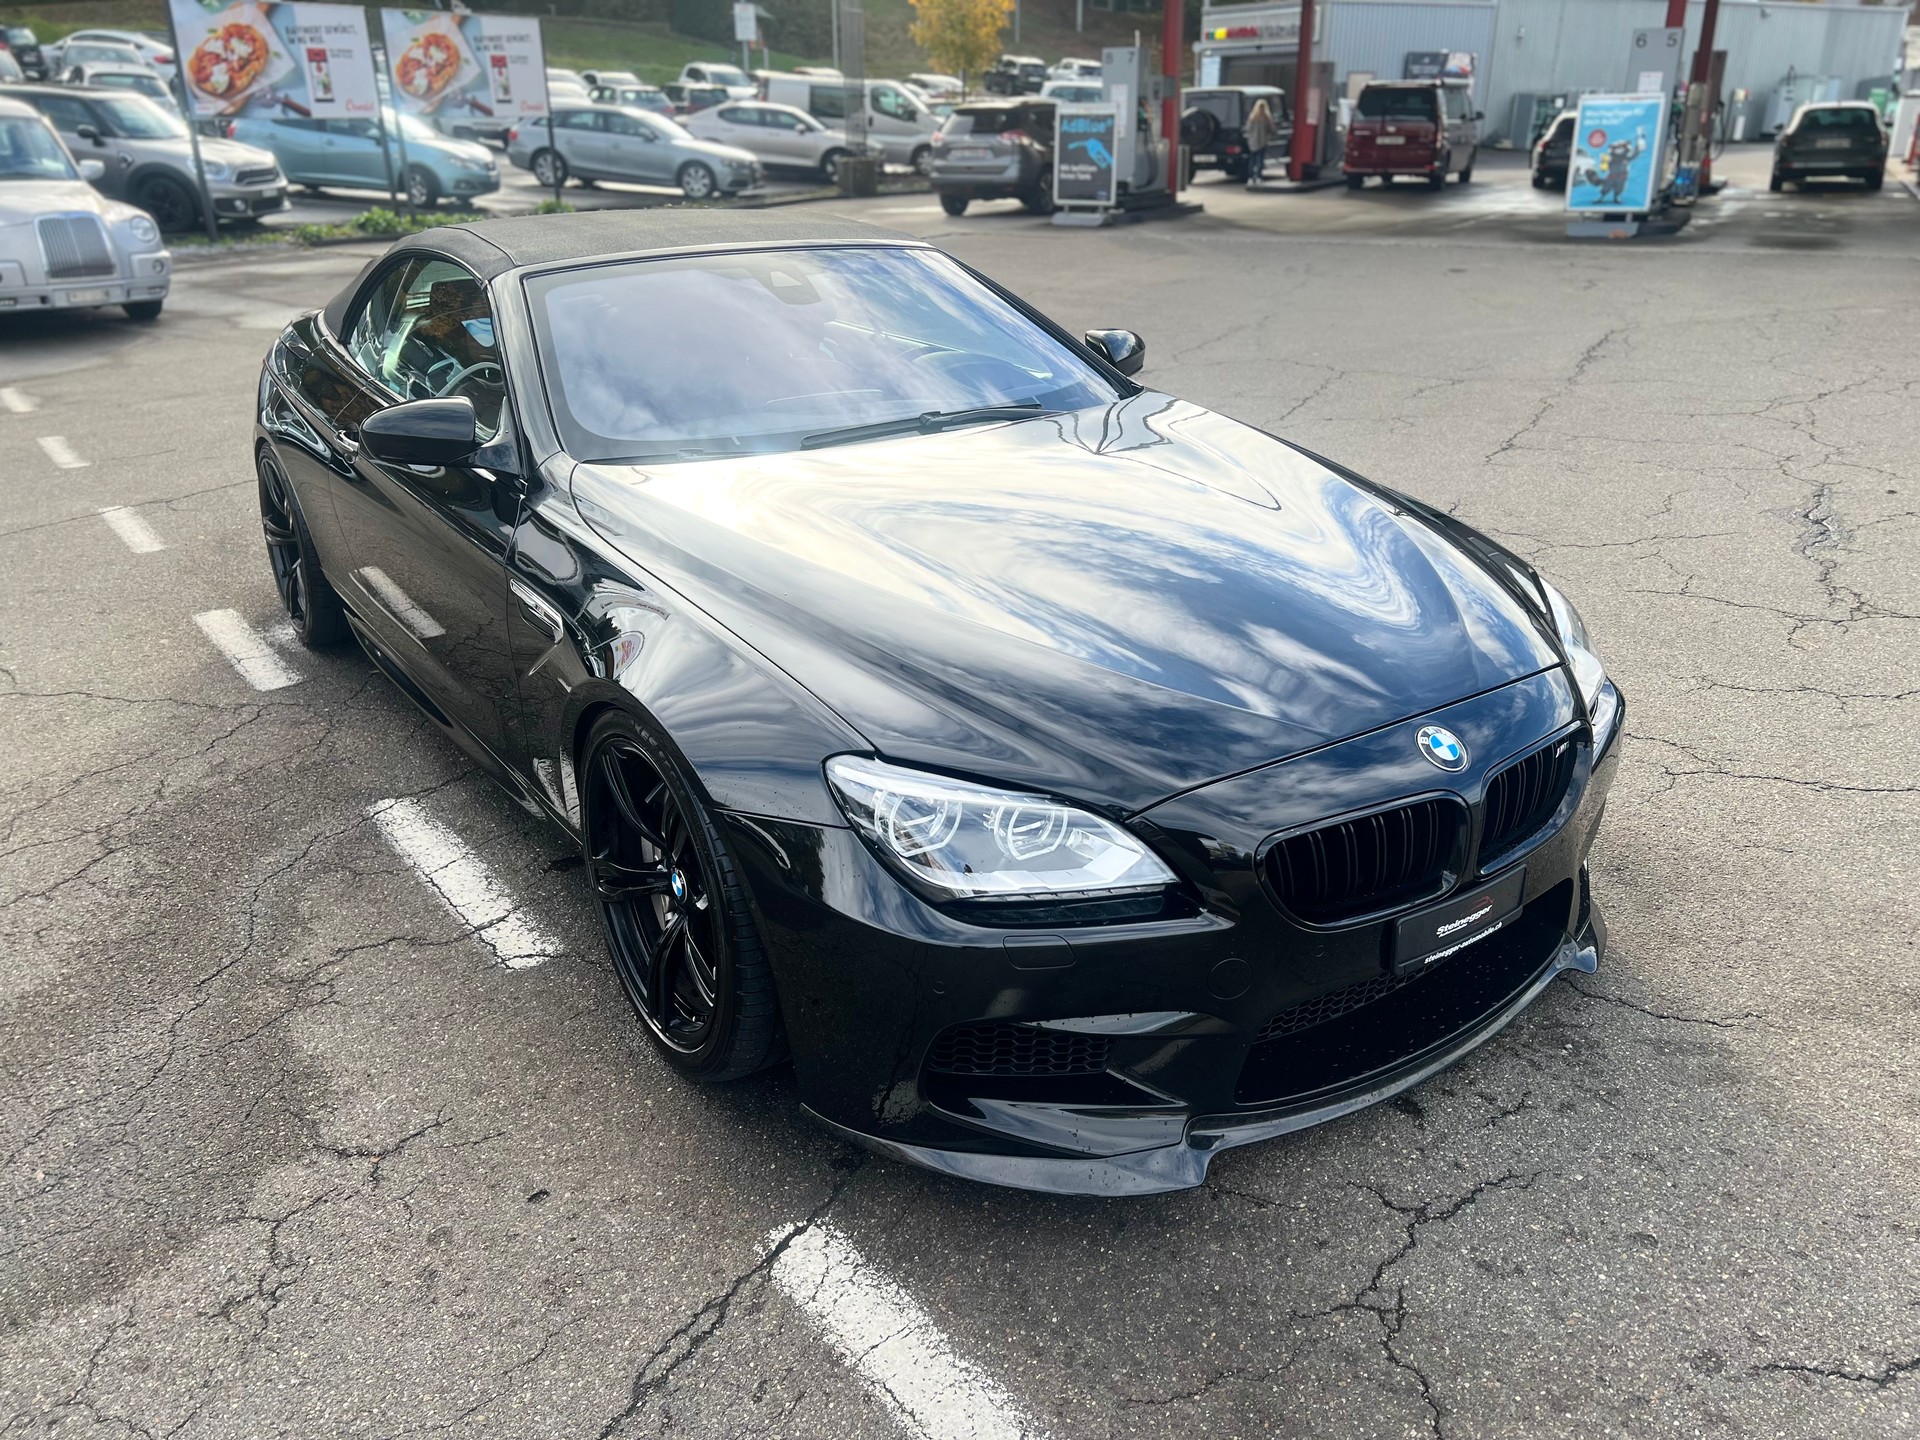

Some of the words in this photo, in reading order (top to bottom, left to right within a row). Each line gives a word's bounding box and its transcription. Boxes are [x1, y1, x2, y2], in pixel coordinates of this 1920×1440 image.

[1635, 32, 1648, 48] 6
[1665, 32, 1678, 48] 5
[1126, 50, 1136, 65] 7
[1436, 905, 1494, 935] Steinegger
